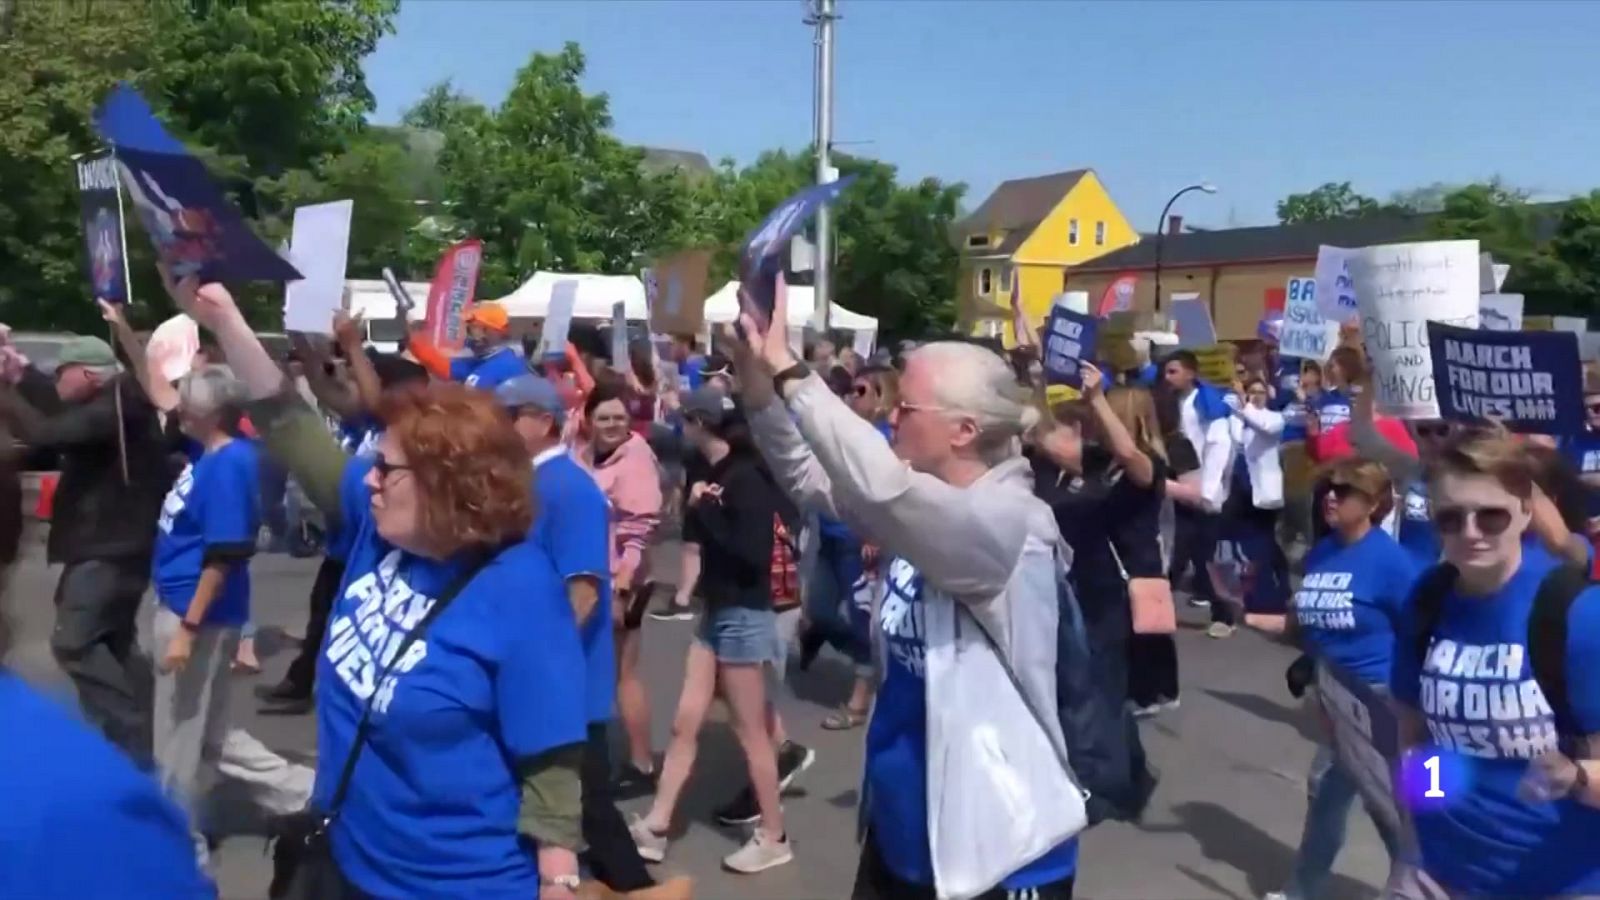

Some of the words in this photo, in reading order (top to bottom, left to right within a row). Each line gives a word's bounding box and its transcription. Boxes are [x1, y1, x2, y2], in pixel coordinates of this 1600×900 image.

[1396, 354, 1424, 367] AND
[1445, 339, 1532, 369] MARCH
[1448, 364, 1488, 395] FOR
[1490, 371, 1554, 396] OUR
[1452, 390, 1513, 420] LIVES
[1419, 675, 1461, 718] OR
[1463, 679, 1555, 720] OUR
